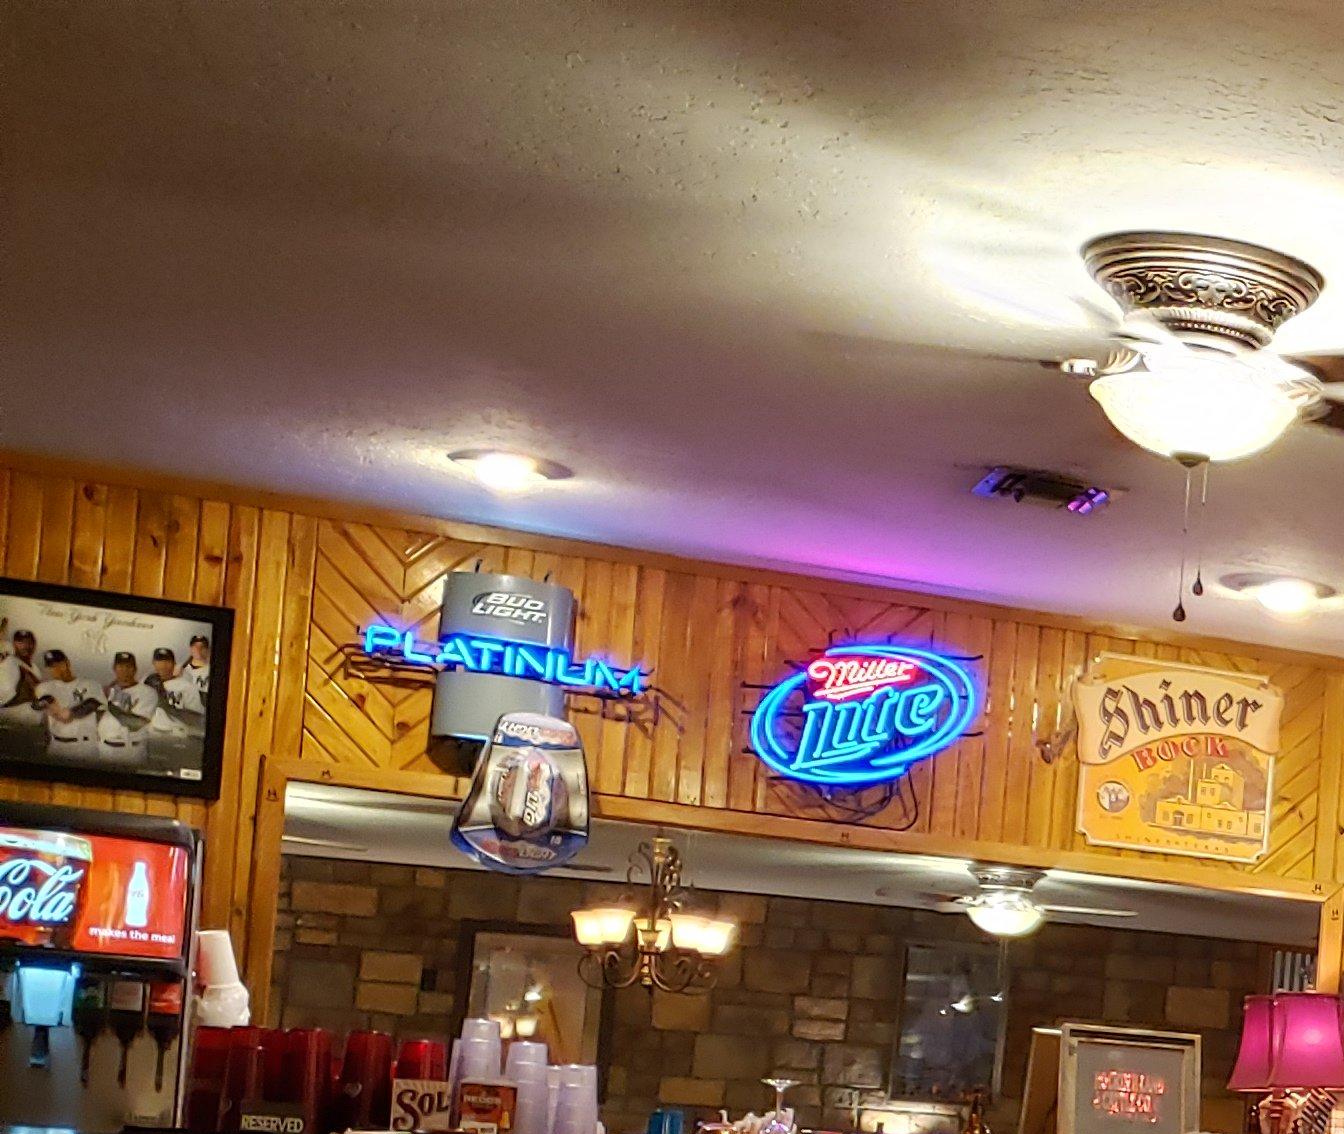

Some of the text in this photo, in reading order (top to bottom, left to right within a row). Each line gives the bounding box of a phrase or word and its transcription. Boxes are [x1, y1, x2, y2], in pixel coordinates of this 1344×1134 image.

[472, 601, 547, 623] LIGHT
[488, 591, 545, 611] BUD
[364, 625, 645, 694] PLATINUM
[806, 659, 915, 691] Miller
[1099, 678, 1264, 760] Shiner
[1131, 735, 1230, 773] BOCK
[88, 926, 176, 944] makes the meal
[240, 1113, 304, 1134] RESERVED
